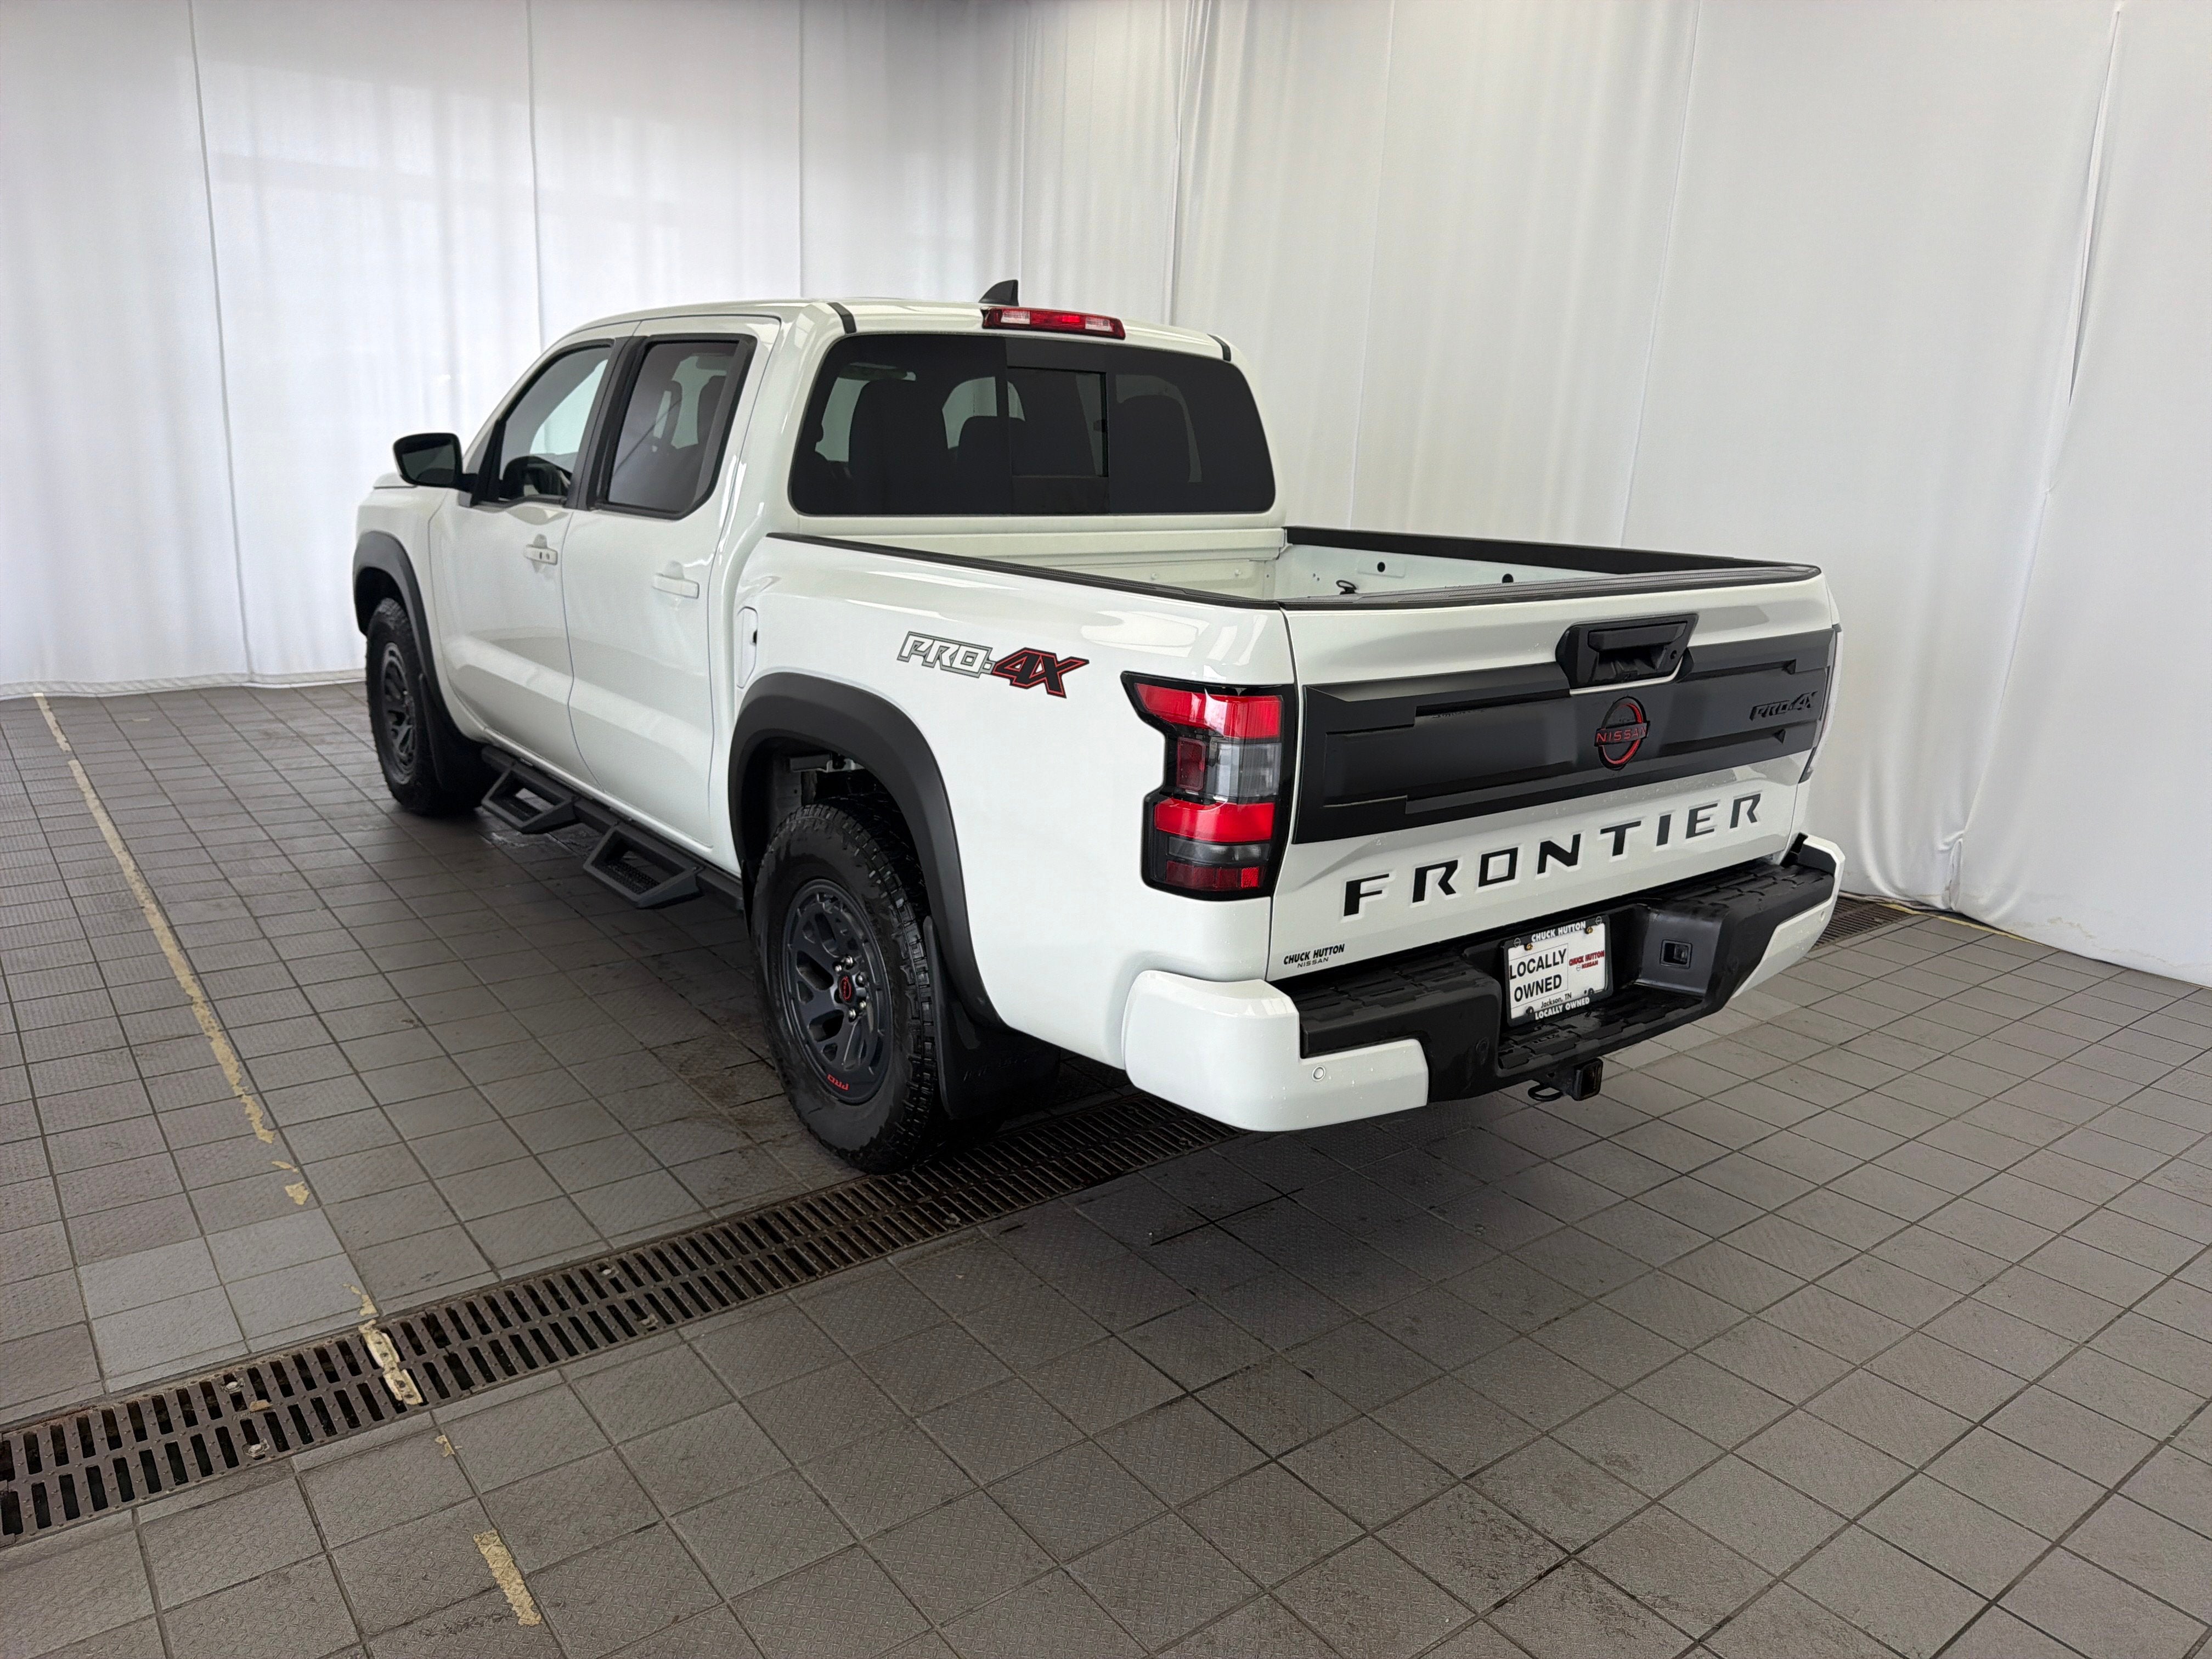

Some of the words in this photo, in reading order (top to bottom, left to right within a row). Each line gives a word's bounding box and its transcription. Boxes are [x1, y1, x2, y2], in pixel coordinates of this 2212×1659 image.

[1596, 725, 1647, 743] NISSAN
[1344, 793, 1761, 916] FRONTIER
[1531, 929, 1555, 942] CHUCK
[1558, 921, 1586, 936] HUTTON
[1284, 951, 1311, 965] CHUCK
[1313, 944, 1345, 958] HUTTON
[1297, 957, 1329, 968] NISSAN
[1510, 949, 1567, 980] LOCALLY
[1569, 955, 1584, 966] CHUCK
[1585, 950, 1605, 962] HUTTON
[1514, 974, 1562, 1002] OWNED
[1534, 1005, 1563, 1020] LOCALLY
[1565, 996, 1590, 1011] OWNED
[1541, 997, 1563, 1008] Jackson,
[1565, 992, 1572, 1000] TN
